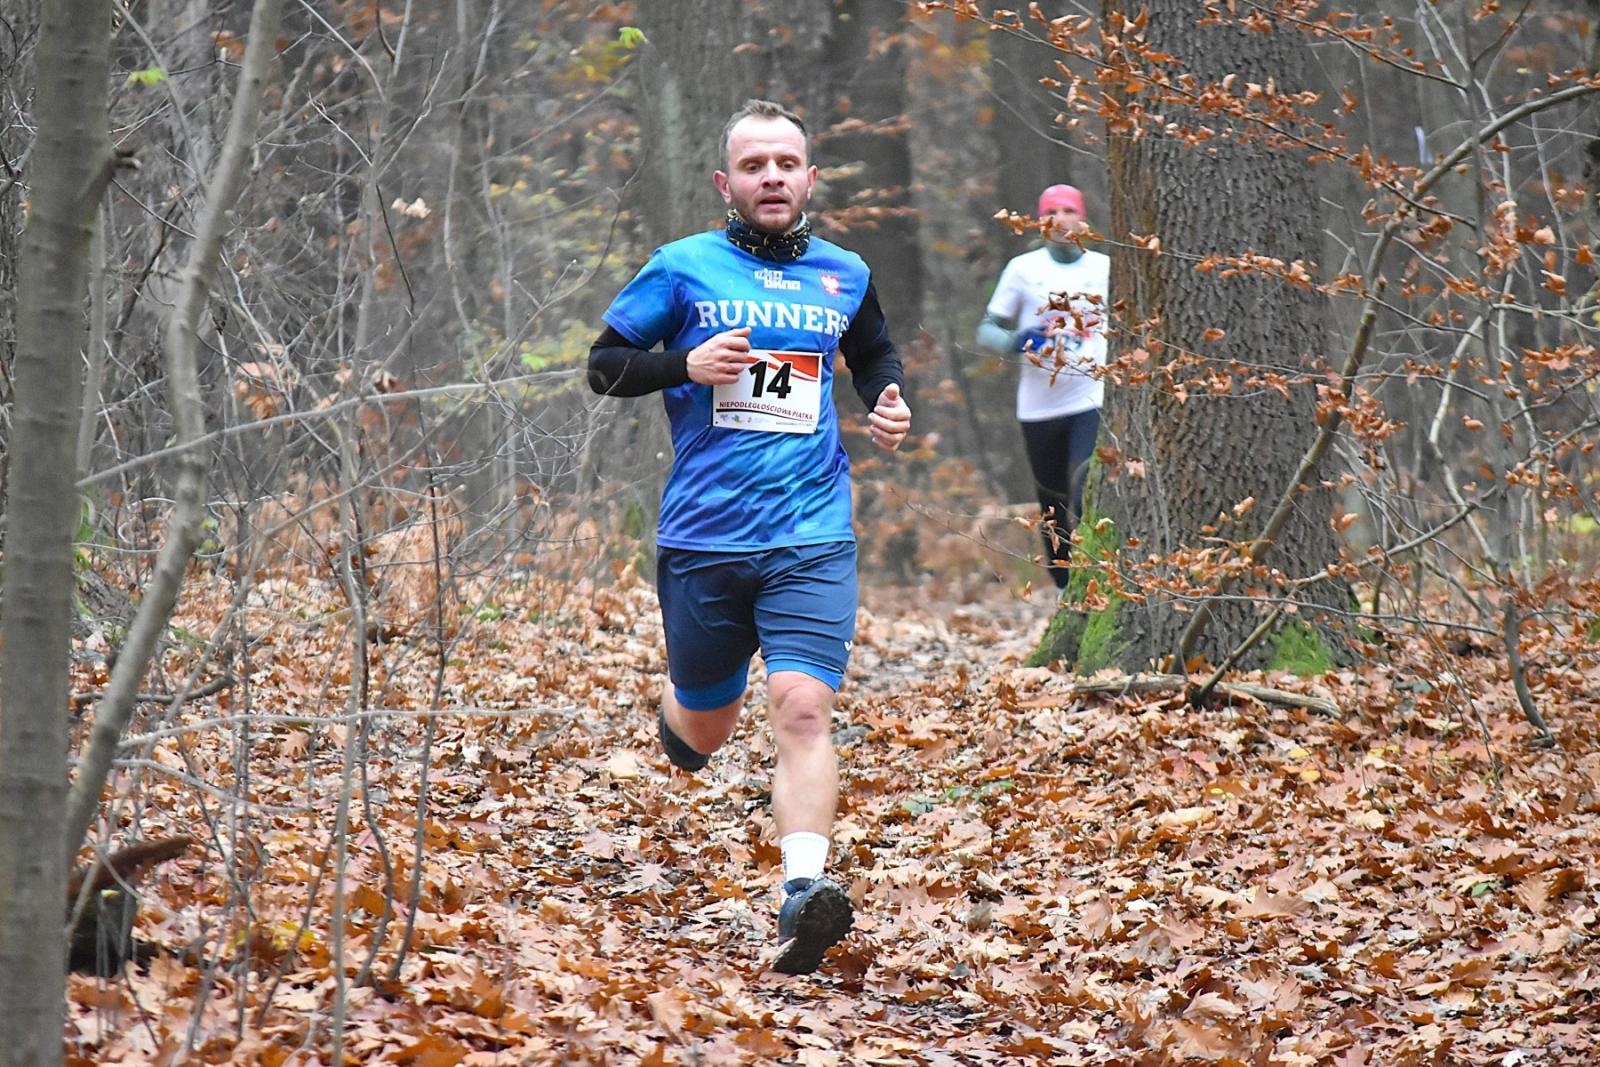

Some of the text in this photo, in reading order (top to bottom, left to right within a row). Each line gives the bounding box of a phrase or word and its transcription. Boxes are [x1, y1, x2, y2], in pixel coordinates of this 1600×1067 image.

[748, 361, 792, 399] 14
[719, 401, 813, 420] NIEPODLEGŁOŚCIOWA PIĄTKA
